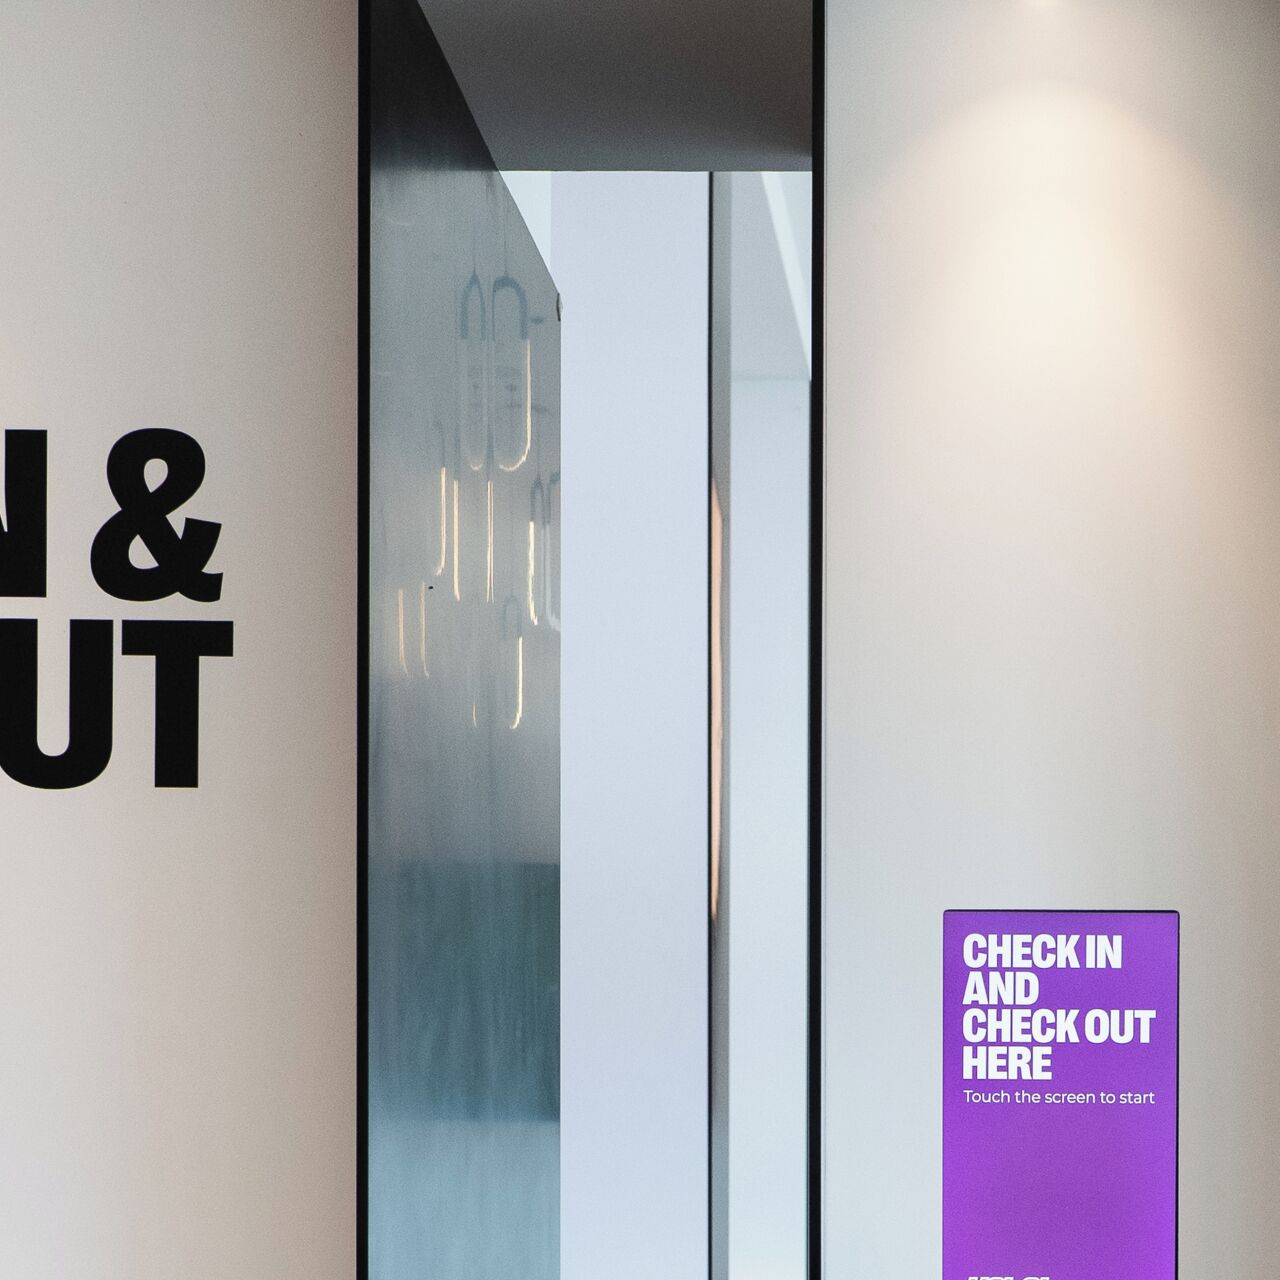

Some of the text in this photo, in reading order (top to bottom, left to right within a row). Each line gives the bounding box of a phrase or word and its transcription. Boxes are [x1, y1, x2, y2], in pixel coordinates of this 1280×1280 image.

[90, 427, 225, 603] &
[962, 932, 1122, 969] CHECK IN
[962, 971, 1040, 1006] AND
[962, 1007, 1156, 1044] CHECK OUT
[962, 1045, 1053, 1081] HERE
[963, 1089, 1156, 1105] Touch the screen to start
